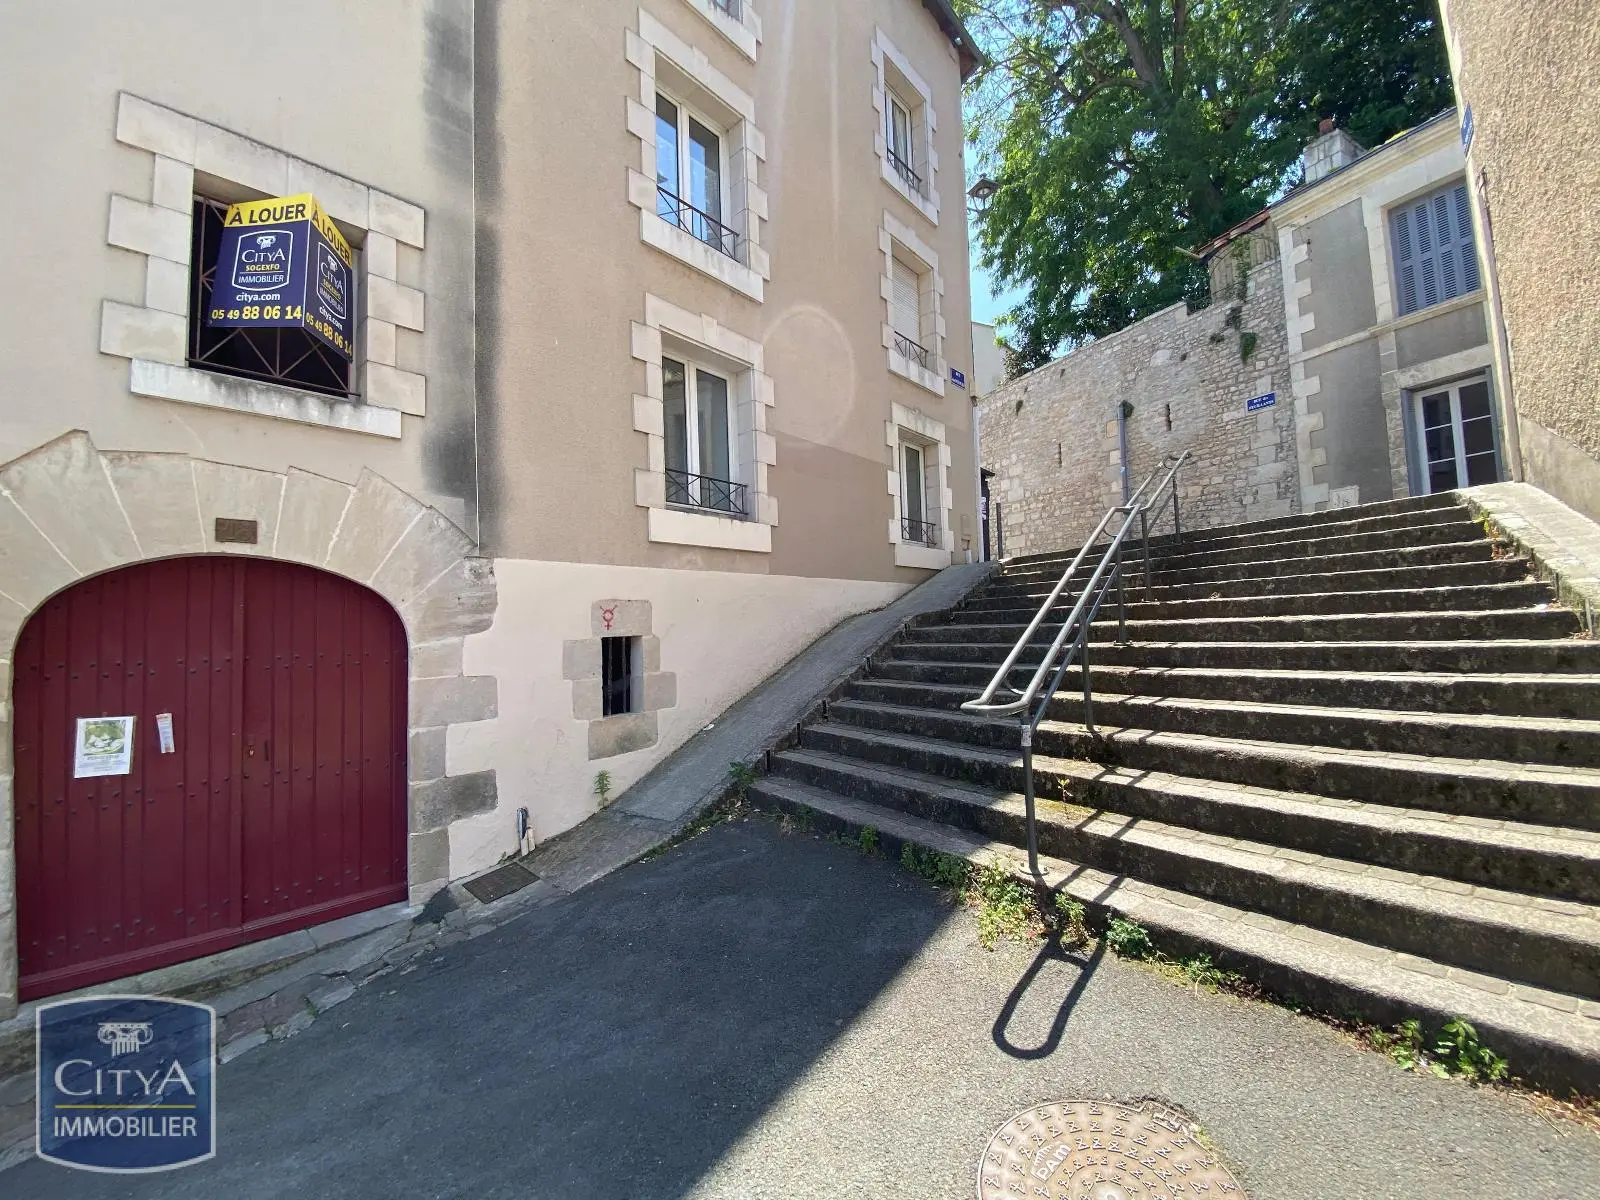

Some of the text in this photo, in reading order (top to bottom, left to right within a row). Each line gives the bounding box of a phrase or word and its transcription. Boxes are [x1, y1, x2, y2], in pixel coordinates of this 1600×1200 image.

[229, 203, 306, 225] À LOUER
[312, 204, 351, 266] À LOUER
[238, 274, 285, 284] IMMOBILIER
[236, 292, 281, 303] citya.com
[211, 305, 302, 320] 05 49 88 06 14
[319, 305, 343, 331] citya.com
[305, 312, 353, 356] 05 49 88 06 14
